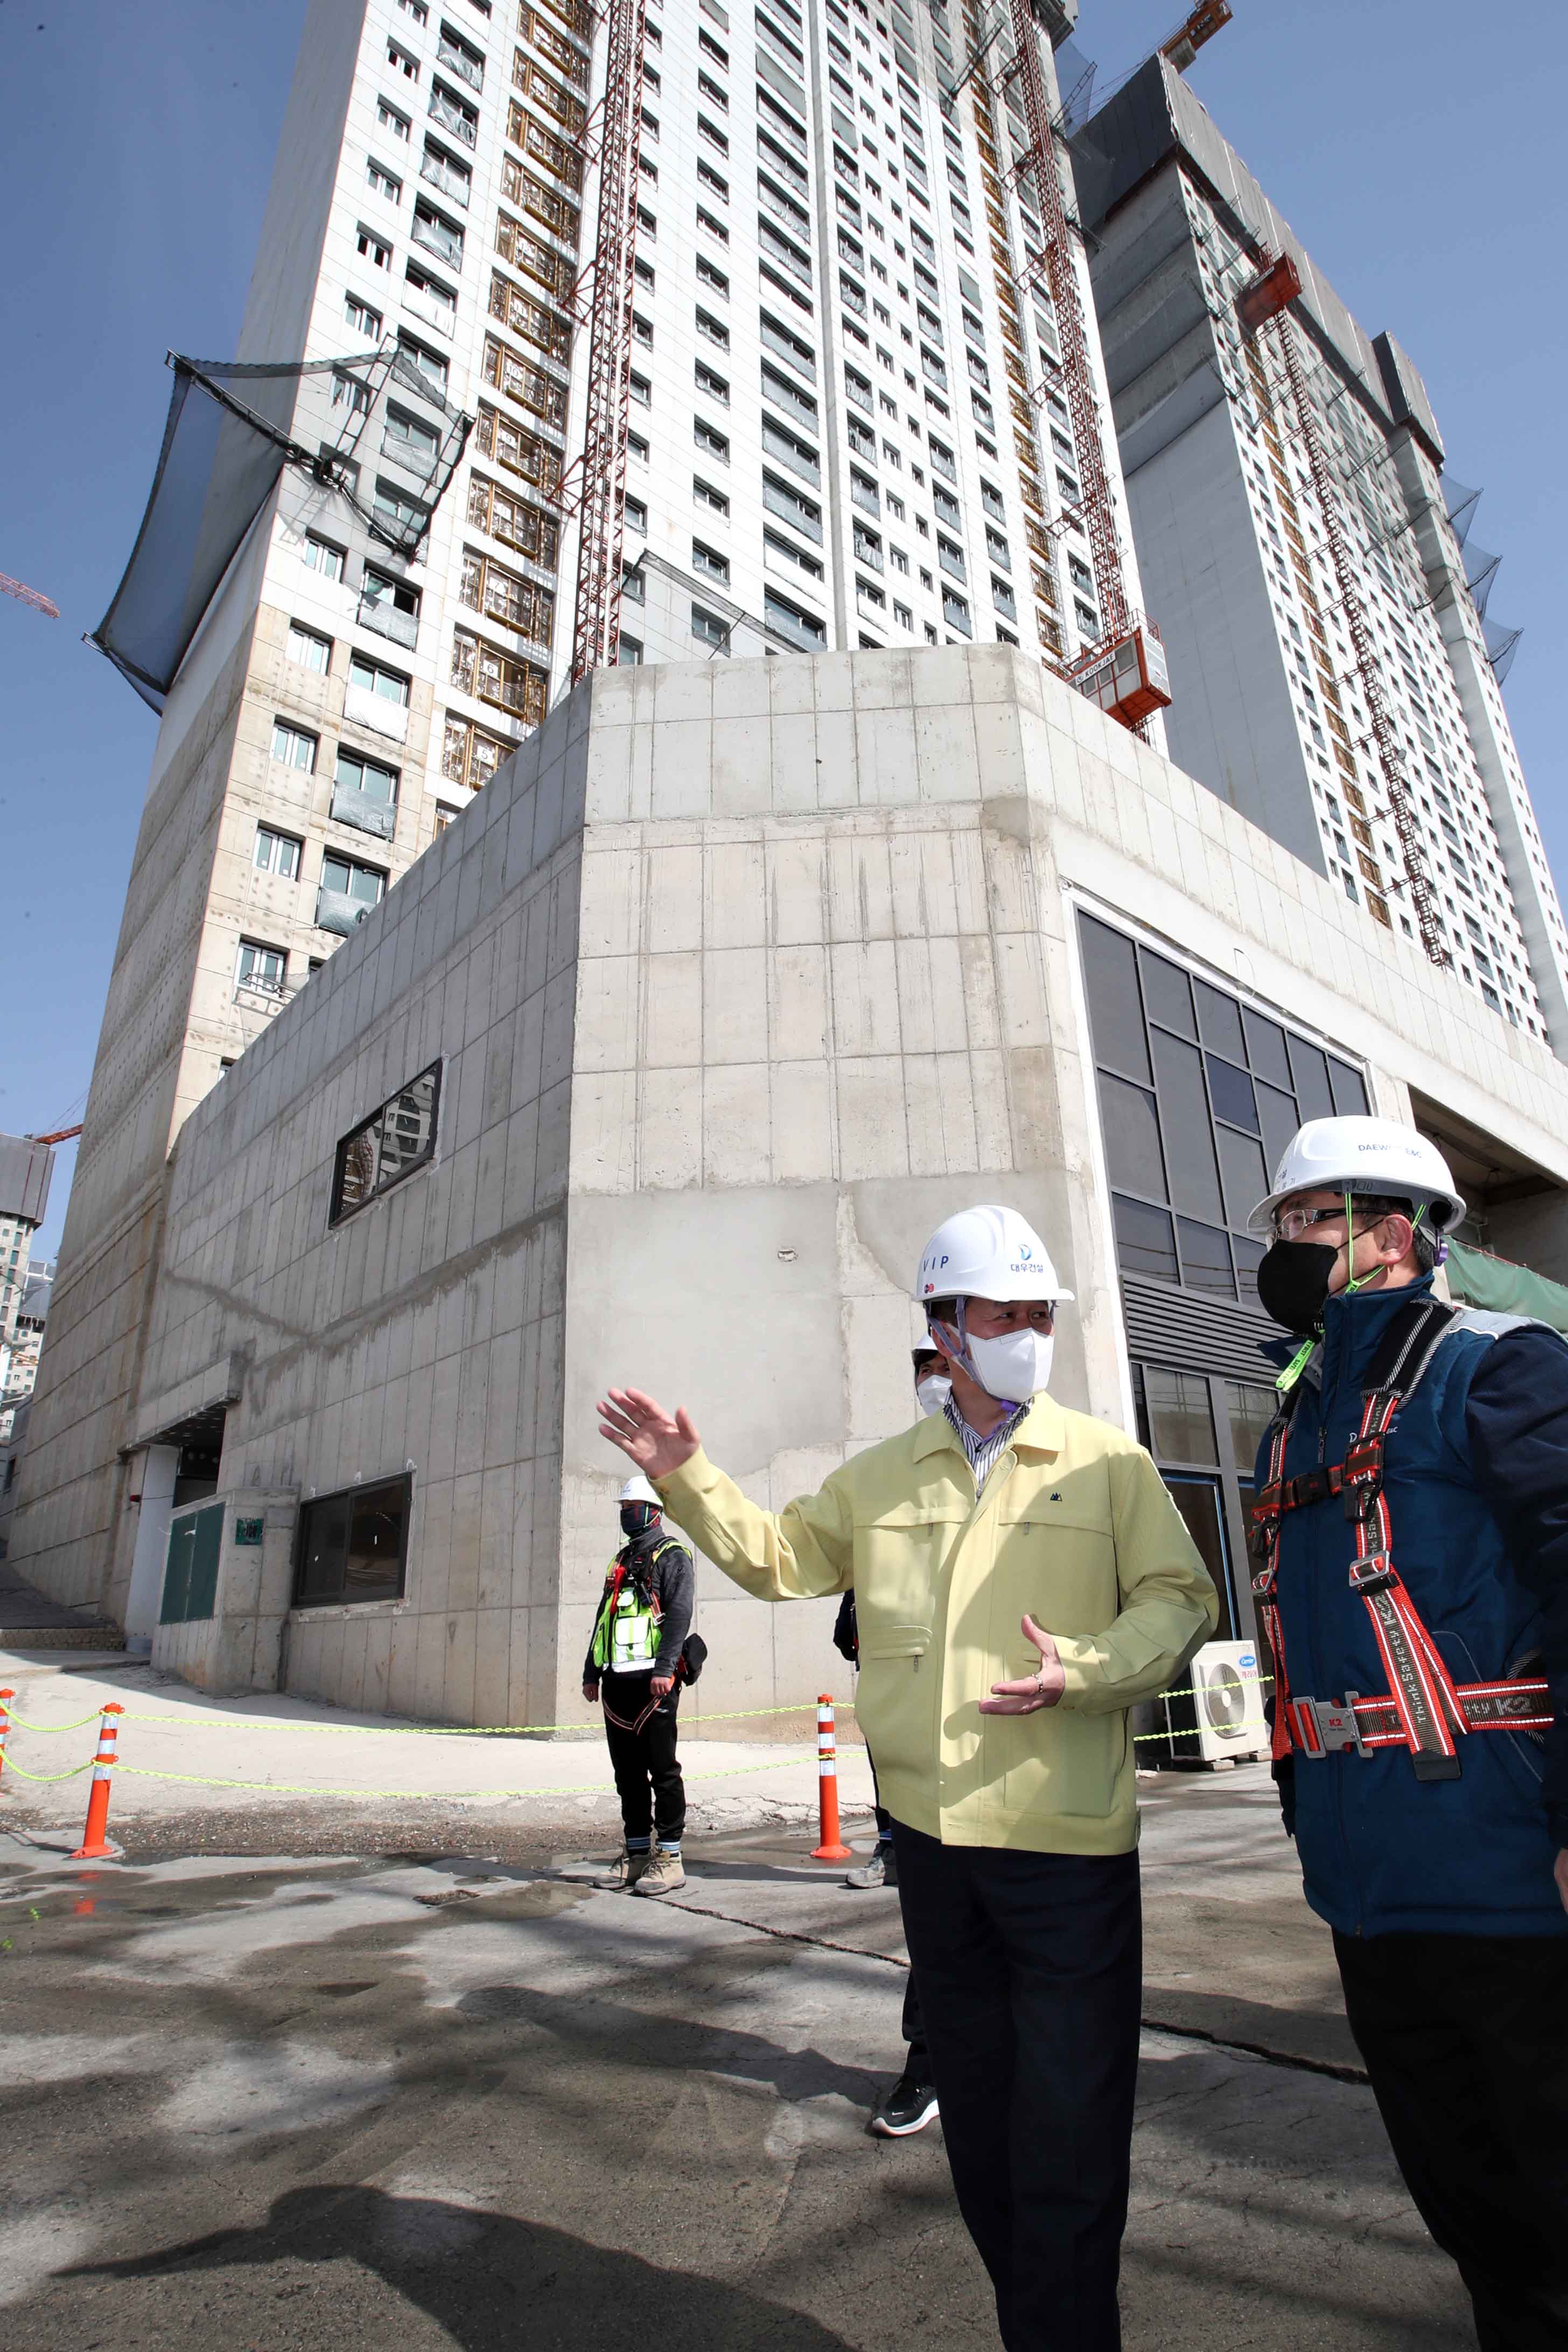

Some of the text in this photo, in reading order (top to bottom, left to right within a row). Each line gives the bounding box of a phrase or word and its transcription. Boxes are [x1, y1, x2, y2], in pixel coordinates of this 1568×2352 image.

[509, 365, 519, 377] 10
[505, 433, 512, 444] 9
[487, 663, 494, 674] 6
[1085, 653, 1114, 677] KOOKJAE
[482, 749, 488, 760] 5
[923, 1255, 949, 1272] VIP
[1010, 1263, 1044, 1273] 대우건설
[1375, 1594, 1427, 1723] Think Safety K2
[1495, 1696, 1533, 1716] K2
[1328, 1718, 1342, 1727] K2
